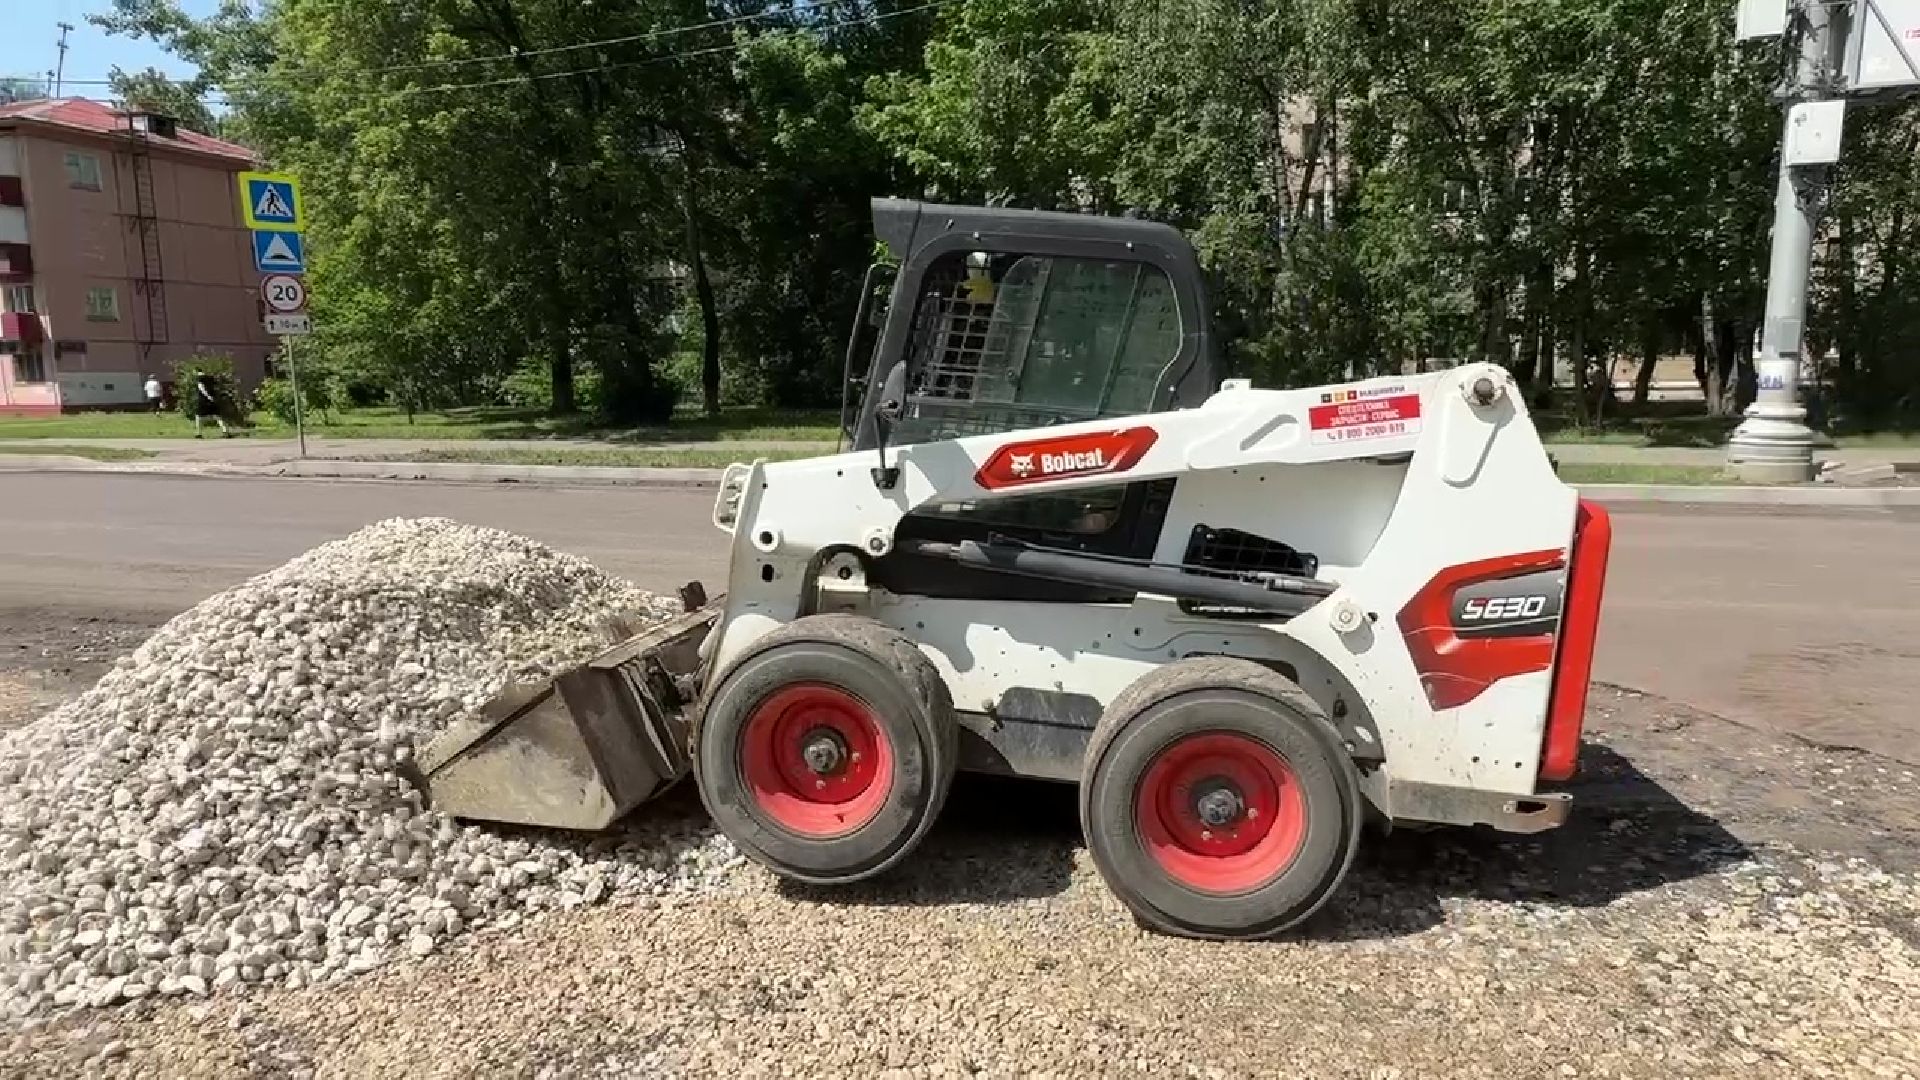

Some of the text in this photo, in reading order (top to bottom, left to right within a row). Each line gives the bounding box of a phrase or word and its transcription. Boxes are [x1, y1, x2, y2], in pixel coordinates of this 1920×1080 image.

[273, 285, 297, 301] 20
[1041, 448, 1105, 474] Bobcat
[1461, 596, 1546, 619] S630
